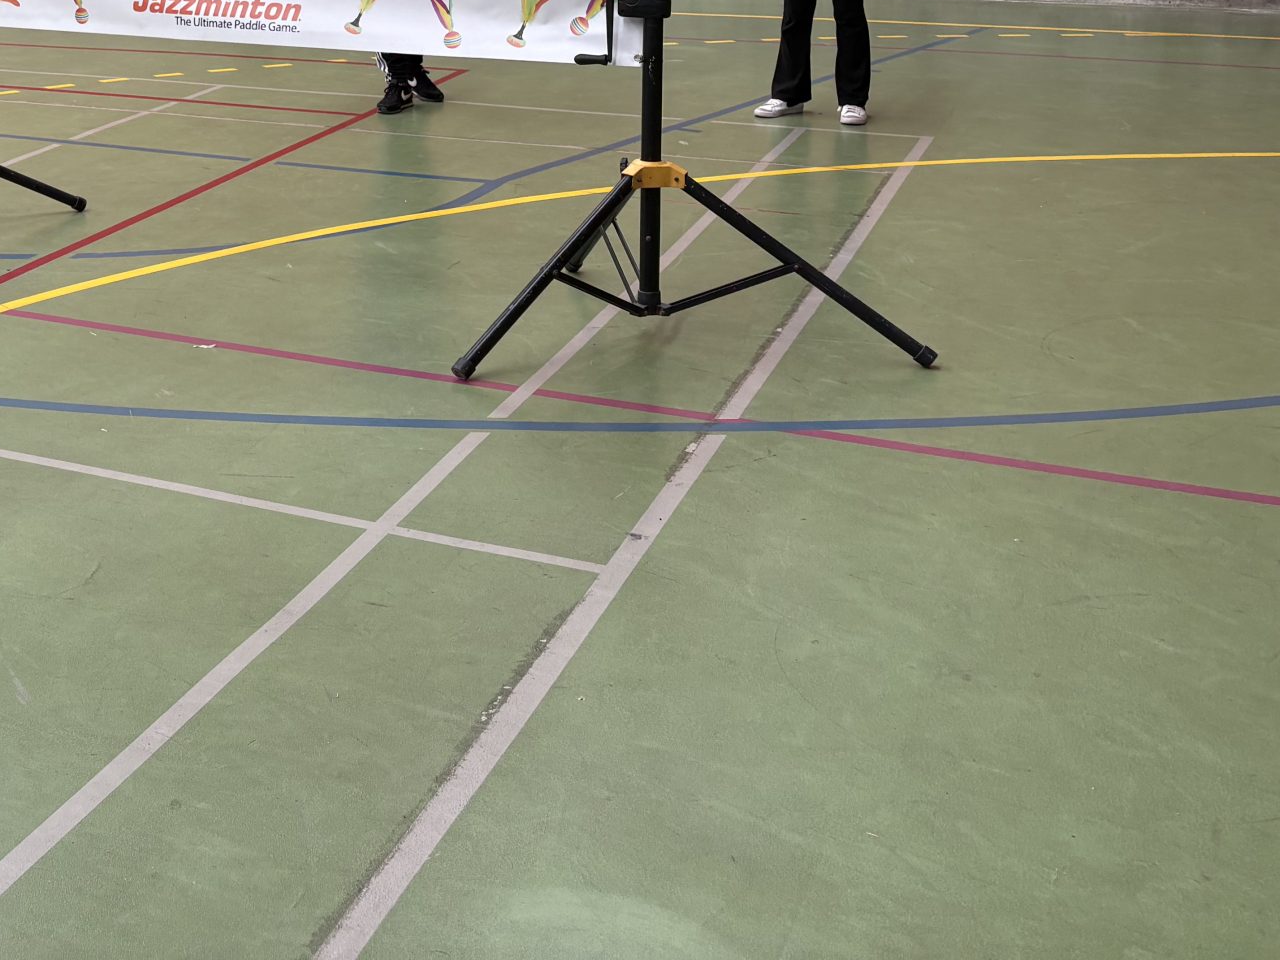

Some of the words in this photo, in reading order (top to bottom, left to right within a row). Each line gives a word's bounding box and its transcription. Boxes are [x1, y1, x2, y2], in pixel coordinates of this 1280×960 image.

[175, 16, 192, 27] The
[193, 17, 233, 29] Ultimate
[234, 20, 266, 31] Paddle
